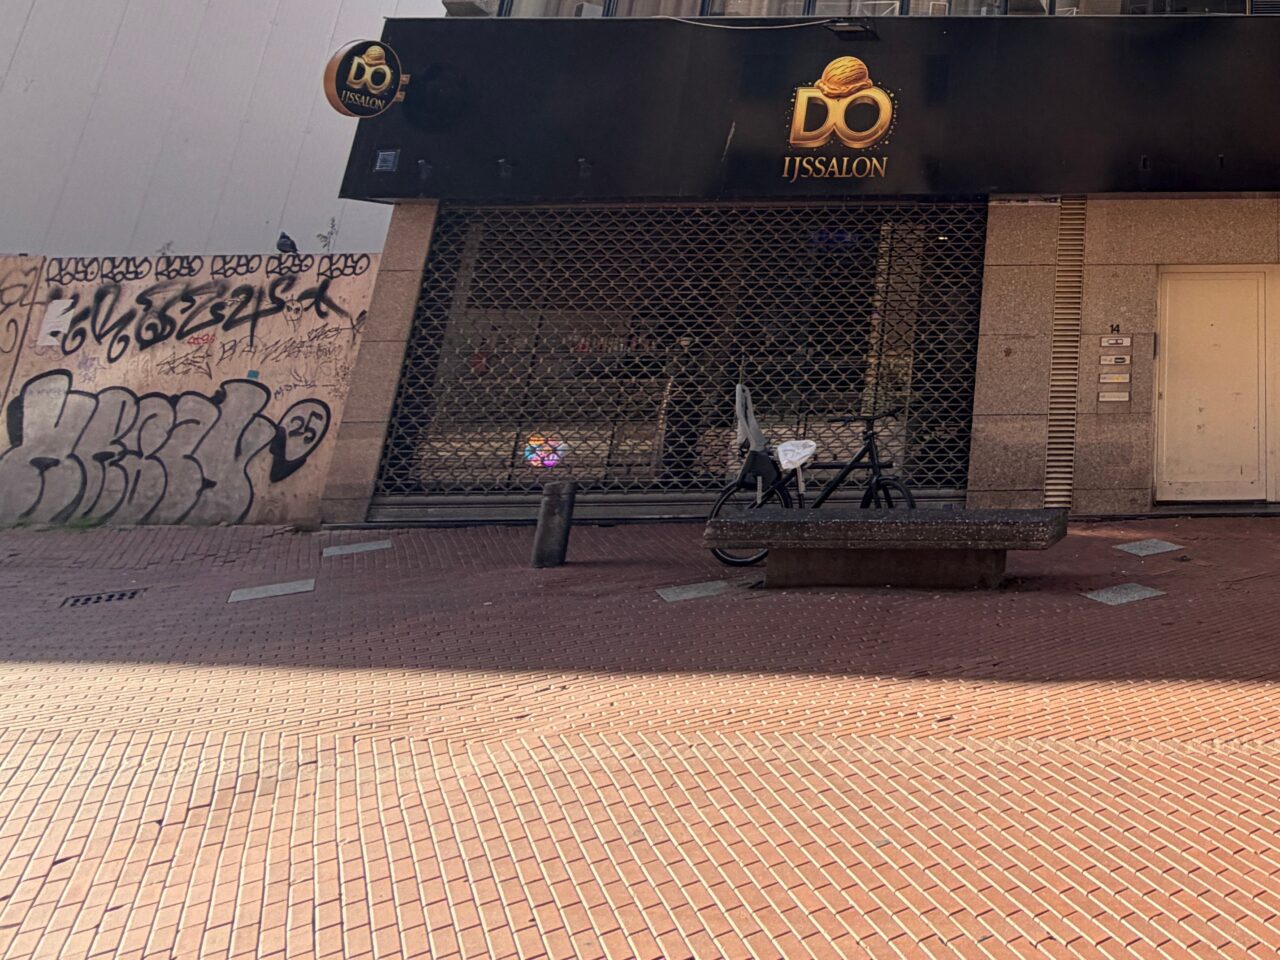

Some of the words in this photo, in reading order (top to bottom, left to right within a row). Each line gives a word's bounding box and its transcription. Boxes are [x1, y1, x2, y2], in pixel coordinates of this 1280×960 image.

[346, 56, 393, 94] DO
[340, 90, 387, 110] IJSSALON
[790, 86, 893, 149] DO
[782, 156, 889, 182] IJSSALON
[1109, 324, 1120, 334] 14
[288, 410, 323, 445] 25
